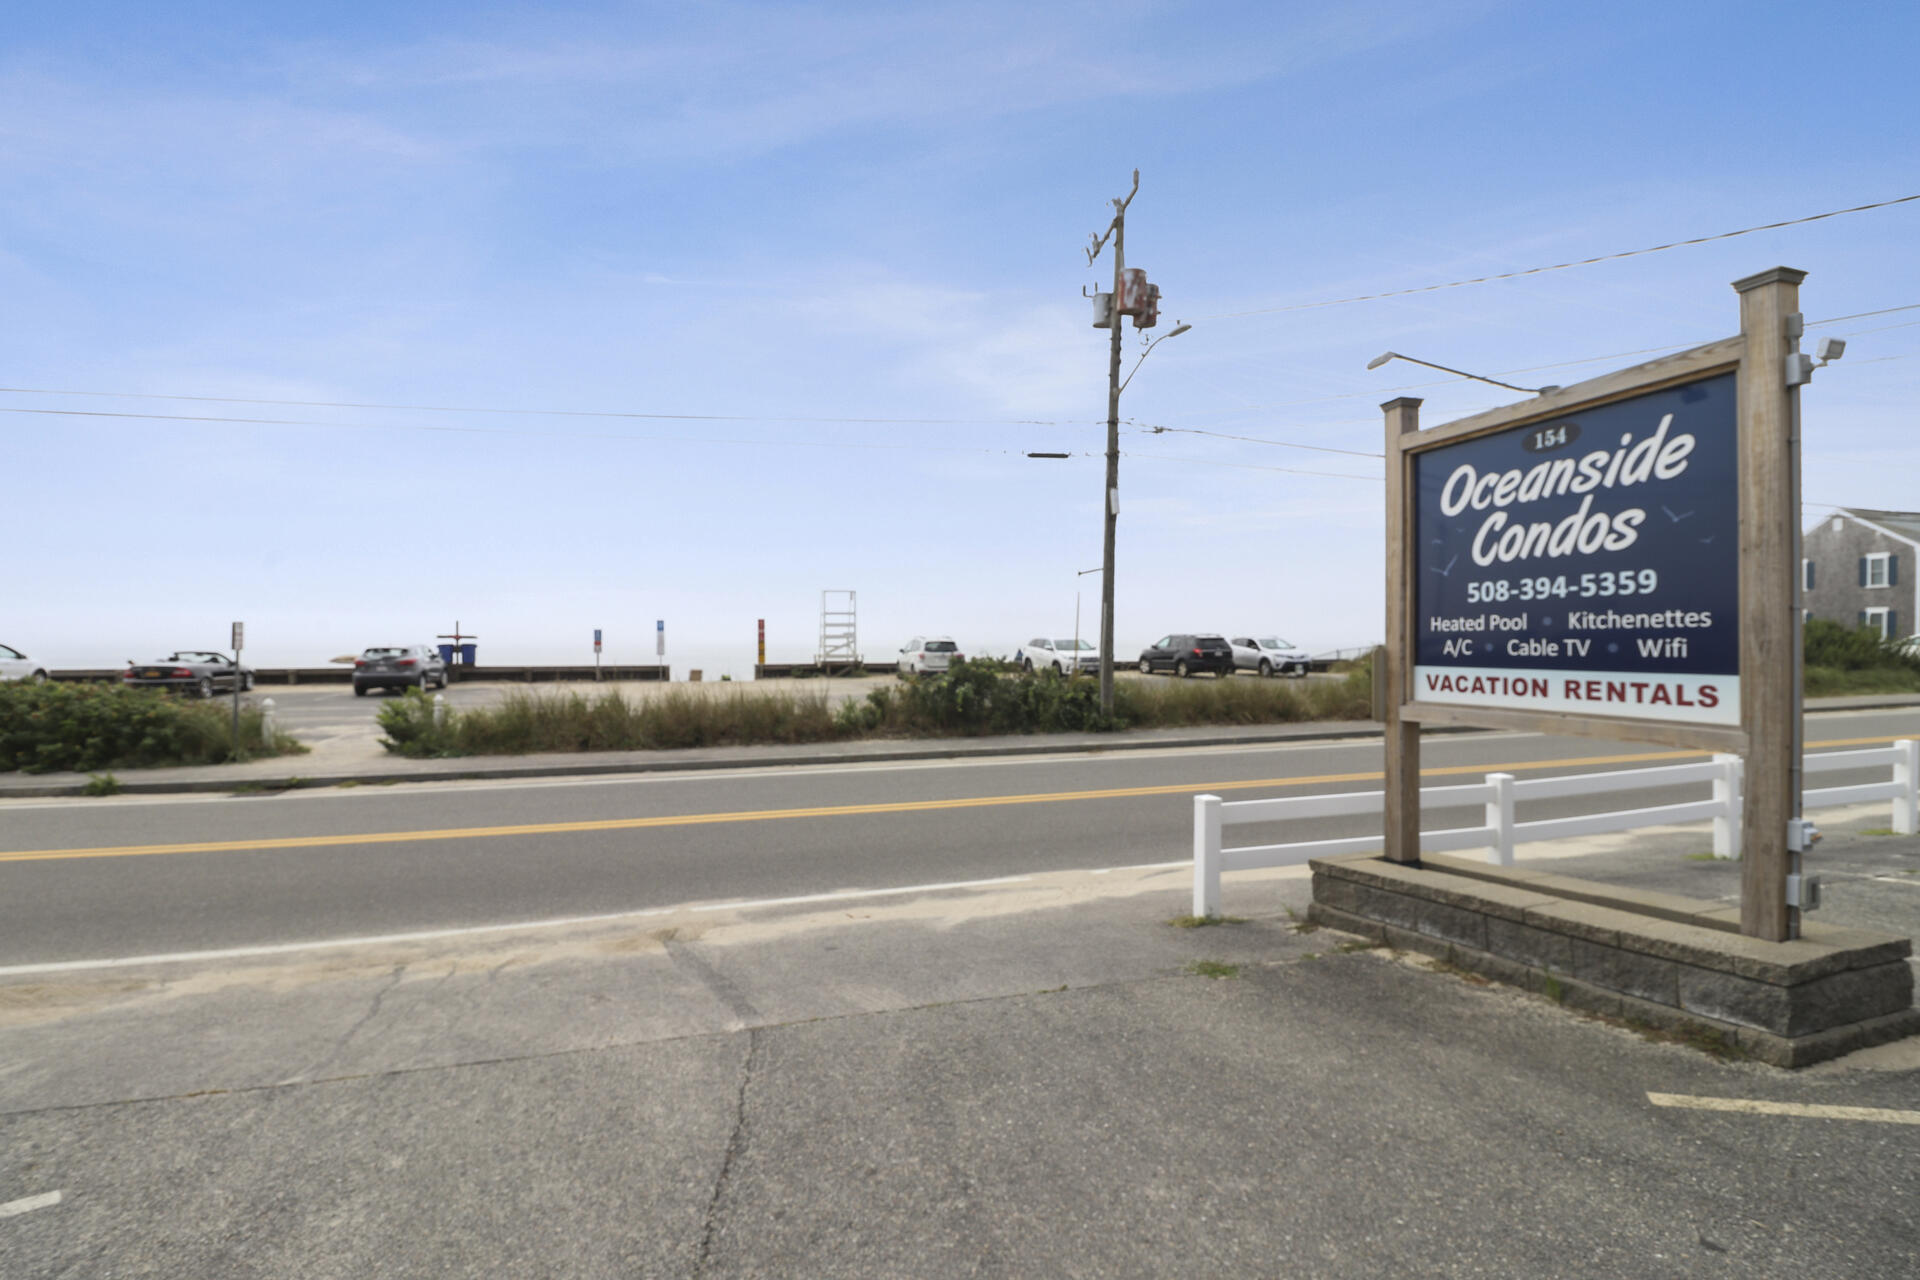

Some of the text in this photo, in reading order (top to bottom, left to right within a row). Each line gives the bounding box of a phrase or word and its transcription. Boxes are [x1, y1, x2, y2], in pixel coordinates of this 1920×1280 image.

[1534, 426, 1567, 449] 154
[1440, 413, 1695, 516] Oceanside
[1471, 494, 1646, 567] Condos
[1467, 569, 1658, 603] 508-394-5359
[1430, 610, 1712, 632] Heated Pool Kitchenettes
[1443, 637, 1687, 658] A/C Cable TV Wifi
[1426, 674, 1720, 708] VACATION RENTALS
